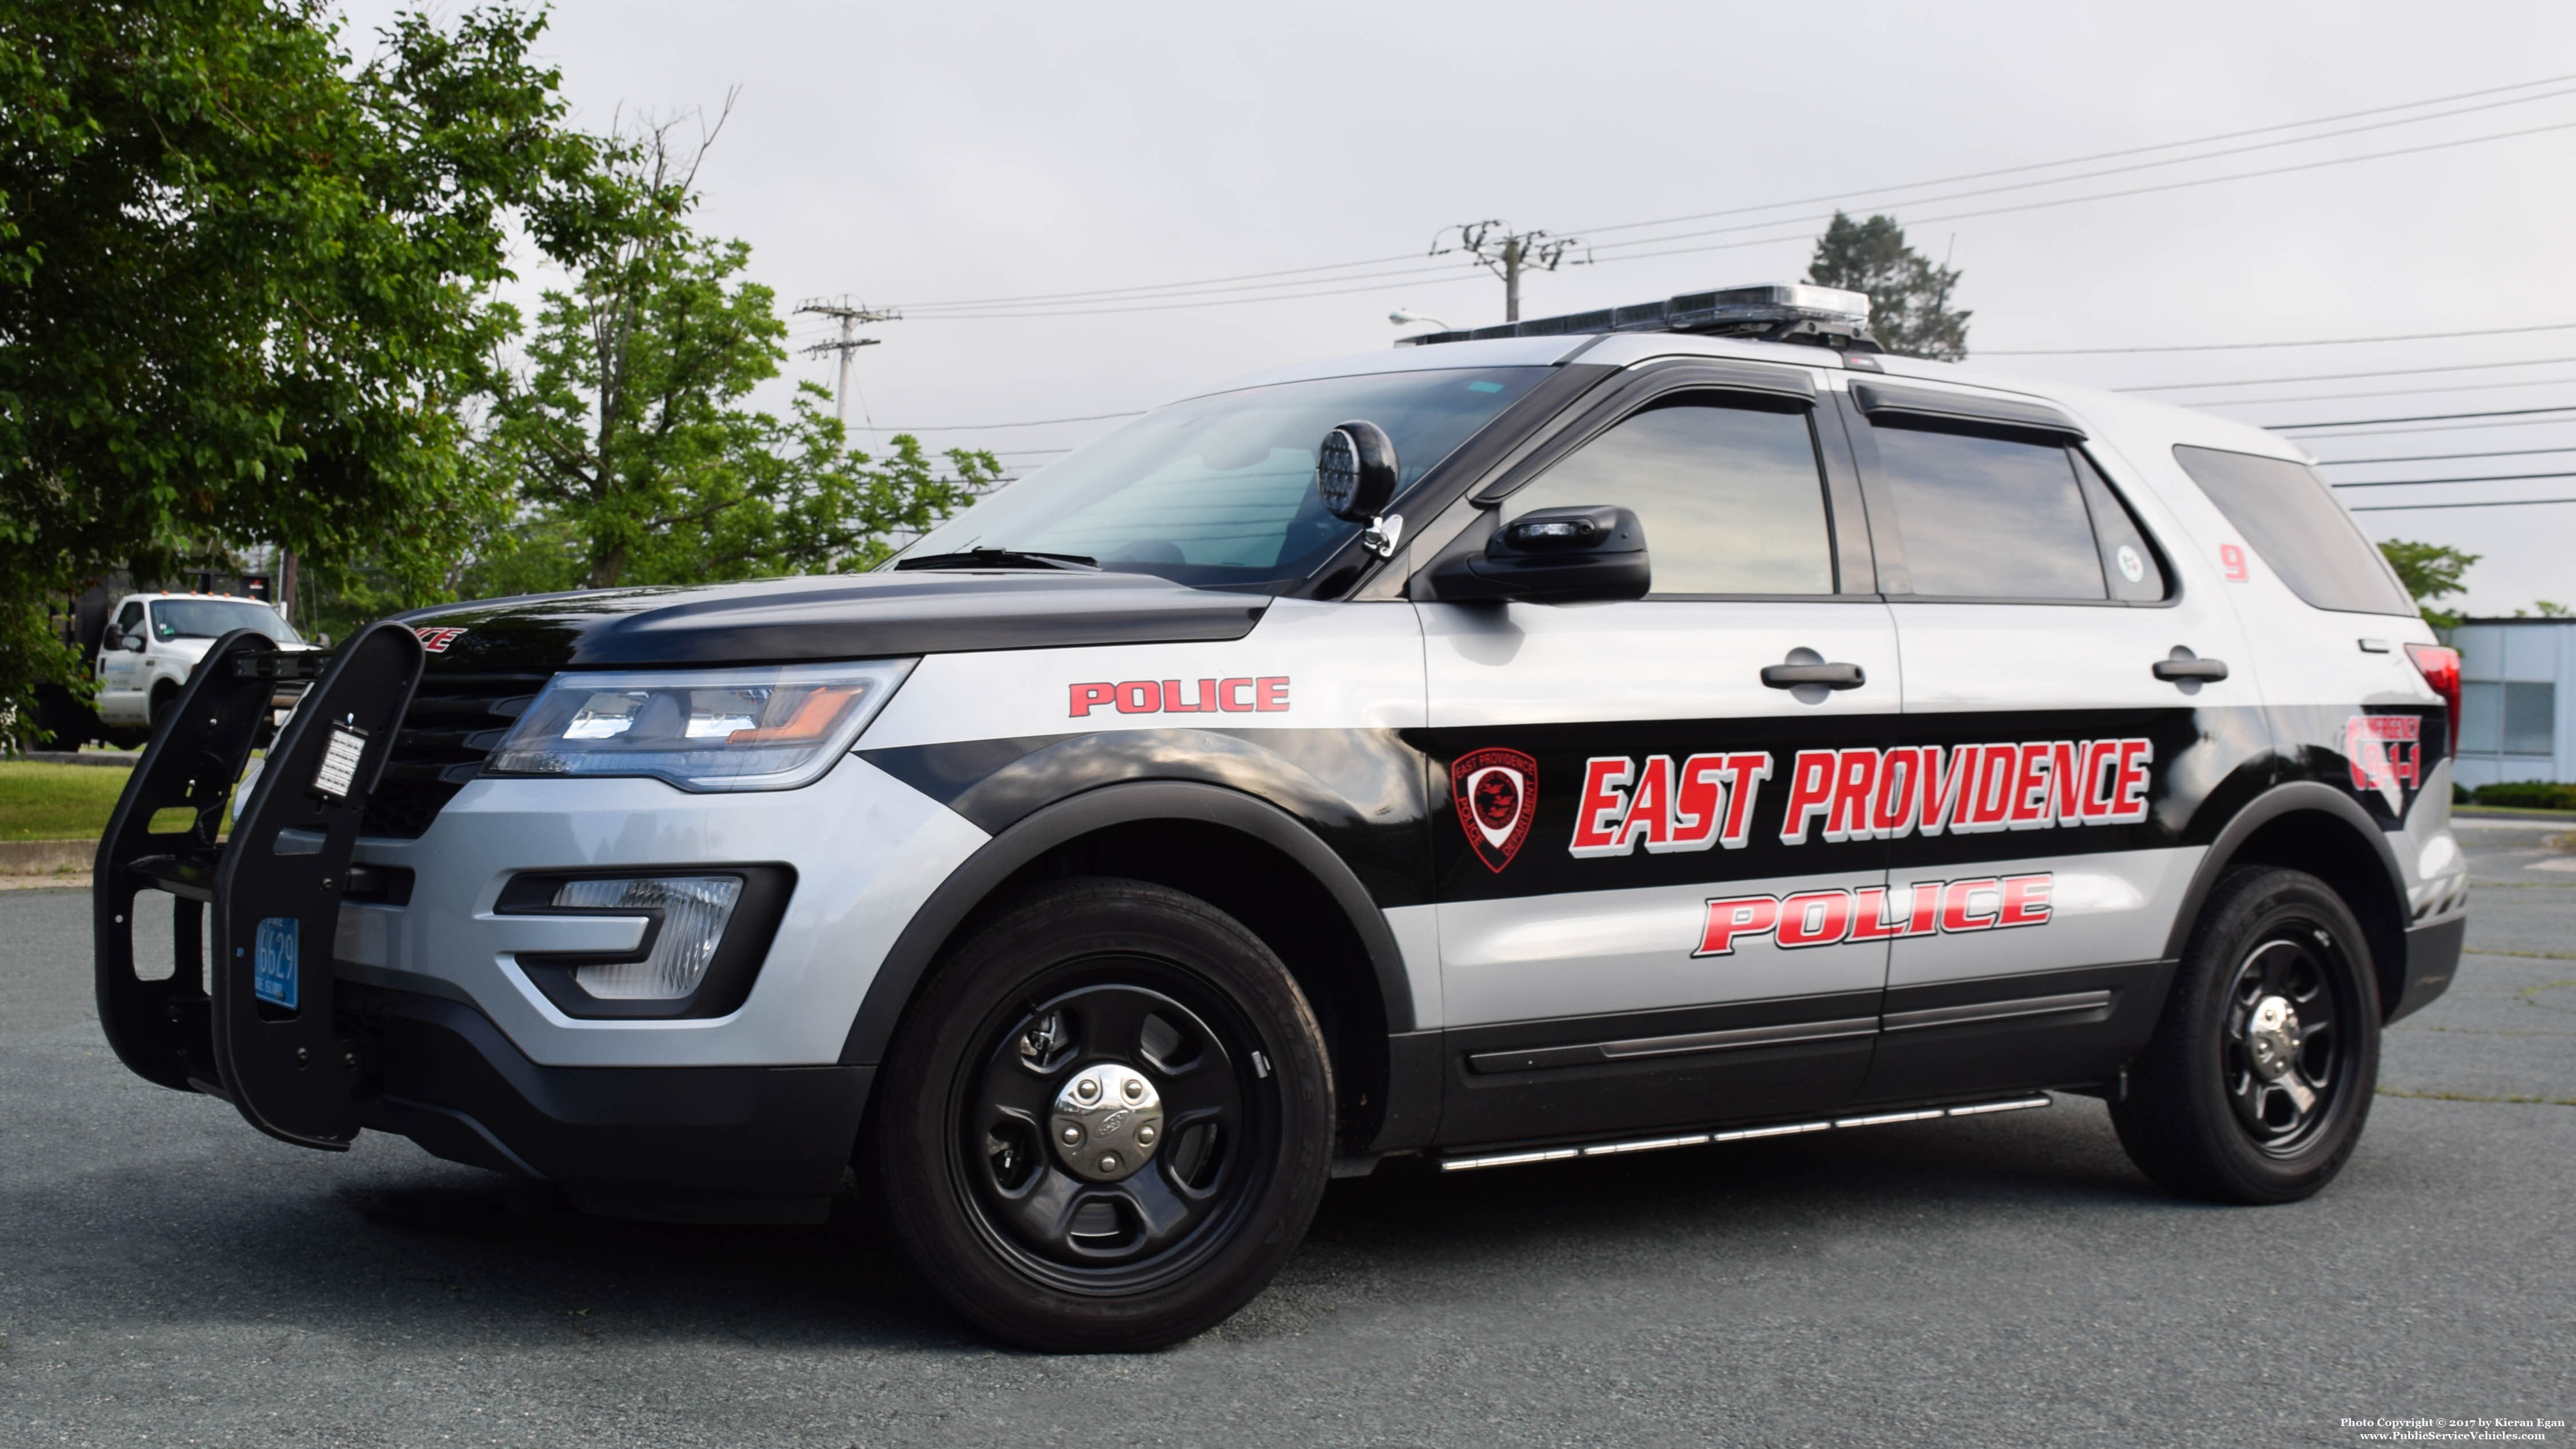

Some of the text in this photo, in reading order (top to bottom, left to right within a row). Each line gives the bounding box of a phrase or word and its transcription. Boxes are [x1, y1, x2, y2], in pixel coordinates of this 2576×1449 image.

[2219, 543, 2249, 583] 9
[1069, 676, 1290, 718] POLICE
[1456, 753, 1535, 779] EAST PROVIDENCE
[1458, 796, 1485, 846] POLICE
[1502, 780, 1534, 857] DEPARTMENT
[1569, 751, 1774, 858] EAST
[1779, 738, 2154, 845] PROVIDENCE
[1690, 871, 2053, 959] POLICE
[261, 929, 293, 980] 6629
